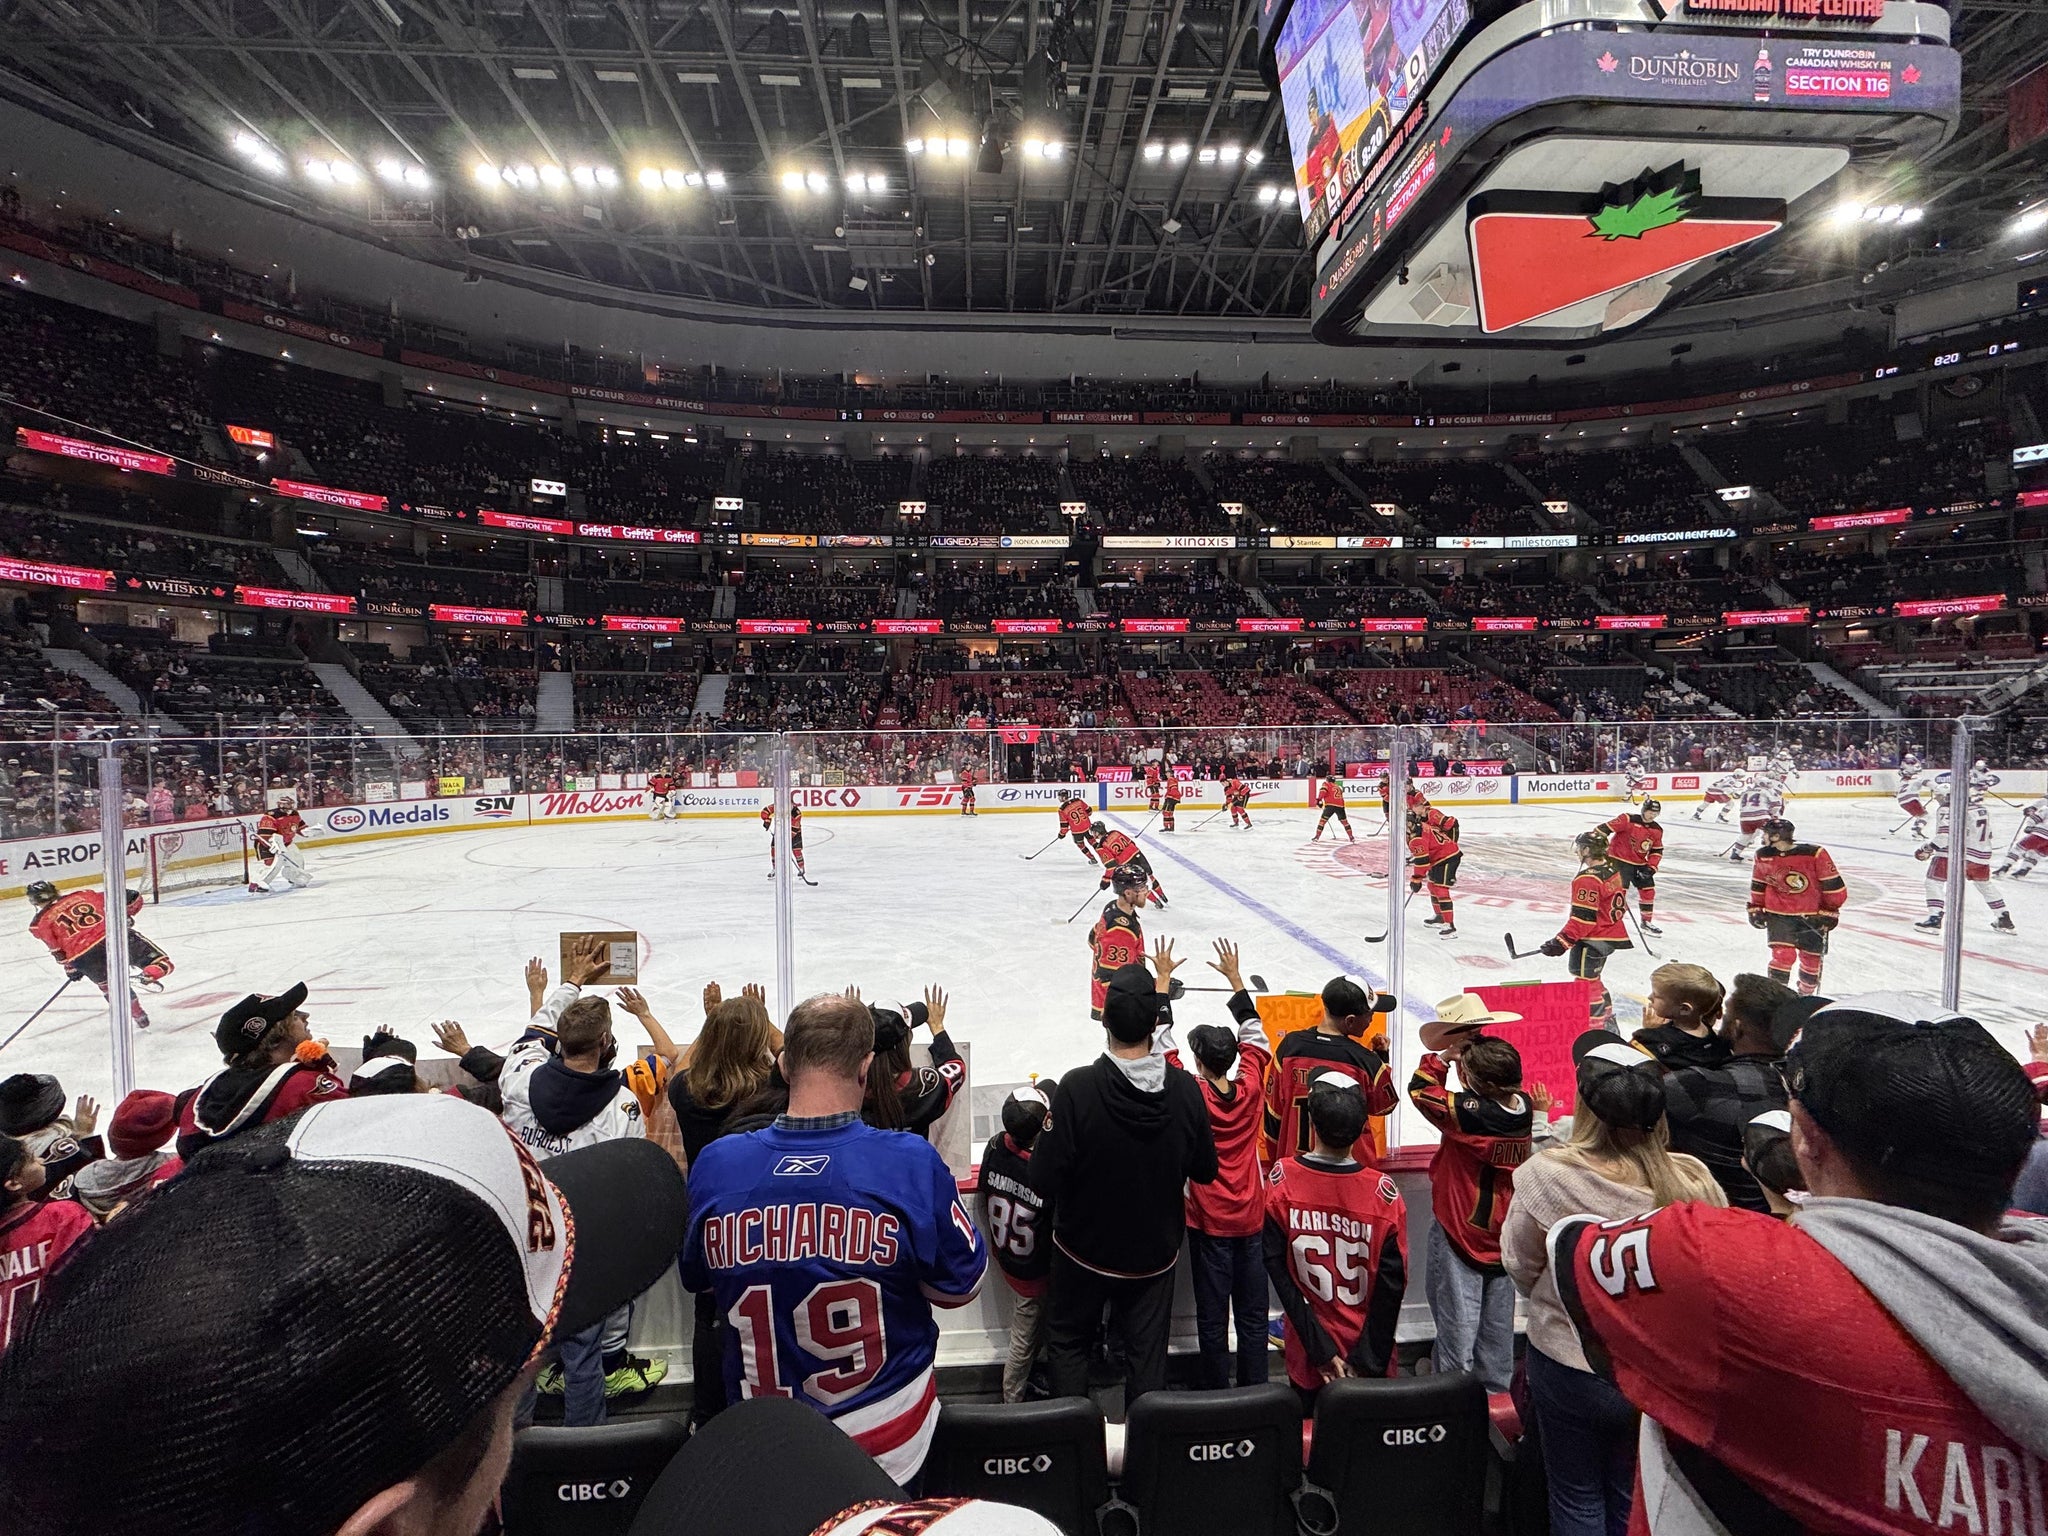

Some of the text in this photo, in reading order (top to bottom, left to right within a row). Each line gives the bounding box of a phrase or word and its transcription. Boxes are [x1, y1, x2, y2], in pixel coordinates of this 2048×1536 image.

[1802, 48, 1876, 60] TRY DUNROBIN
[1629, 56, 1740, 80] DUNROBIN
[1786, 57, 1892, 70] CANADIAN WHISKY IN
[1788, 75, 1889, 93] SECTION 116
[1361, 126, 1384, 168] 8:20
[1386, 158, 1435, 225] SECTION 116
[264, 314, 351, 346] GO GO
[571, 387, 704, 411] DU COEUR ARTIFICES
[883, 411, 935, 420] GO GO
[1056, 413, 1133, 422] HEART HYPE
[1261, 415, 1310, 424] GO GO
[1439, 413, 1553, 425] DU COEUR ARTIFICES
[61, 445, 141, 468] SECTION 116
[302, 491, 362, 507] SECTION 116
[415, 506, 453, 518] WHISKY
[1940, 502, 1985, 514] WHISKY
[505, 519, 540, 532] SECTION
[541, 523, 553, 532] 116
[1833, 517, 1872, 528] SECTION
[1872, 516, 1885, 525] 116
[1752, 523, 1798, 535] DUNROBIN
[931, 536, 971, 547] ALIGNED
[1013, 538, 1070, 546] KONICA MINOLTA
[1296, 538, 1322, 546] Stantec
[1511, 537, 1570, 547] milestones
[1624, 532, 1685, 544] ROBERTSON
[60, 575, 81, 587] 116
[145, 580, 209, 596] WHISKY
[264, 597, 332, 611] SECTION 116
[367, 603, 423, 616] DUNROBIN
[1916, 604, 1963, 615] SECTION
[1964, 603, 1981, 612] 116
[452, 613, 508, 624] SECTION 116
[1828, 607, 1874, 618] WHISKY
[546, 616, 585, 626] WHISKY
[1075, 621, 1108, 630] WHISKY
[1195, 621, 1232, 630] DUNROBIN
[1316, 620, 1348, 629] WHISKY
[1432, 620, 1468, 629] DUNROBIN
[1550, 619, 1582, 628] WHISKY
[1610, 621, 1640, 630] SECTION
[1641, 620, 1651, 629] 116
[1673, 616, 1717, 626] DUNROBIN
[1740, 616, 1775, 625] SECTION
[1777, 614, 1789, 623] 116
[621, 622, 656, 631] SECTION
[691, 622, 732, 631] DUNROBIN
[753, 625, 796, 633] SECTION 116
[825, 623, 858, 631] WHISKY
[888, 625, 928, 633] SECTION 116
[950, 622, 987, 631] DUNROBIN
[1007, 624, 1047, 633] SECTION 116
[1136, 624, 1175, 632] SECTION 116
[1251, 623, 1290, 631] SECTION 116
[1375, 623, 1413, 631] SECTION 116
[1486, 622, 1513, 631] SECTION
[1514, 622, 1524, 630] 116
[1527, 779, 1591, 793] Mondetta
[473, 796, 515, 812] SN
[539, 792, 644, 816] Molson
[682, 793, 717, 807] Coors
[718, 797, 760, 806] SELTZER
[791, 789, 838, 807] CIBC
[333, 814, 360, 826] Esso
[368, 803, 450, 827] Medals
[1975, 818, 1988, 842] 7
[1576, 888, 1598, 903] 85
[56, 902, 105, 939] 18
[1107, 945, 1129, 963] 33
[520, 1125, 573, 1154] BURGESS
[987, 1170, 1044, 1209] SANDERSON
[986, 1194, 1037, 1258] 85
[1289, 1208, 1373, 1244] KARLSSON
[704, 1202, 900, 1270] RICHARDS
[1291, 1233, 1371, 1307] 65
[727, 1276, 888, 1407] 19
[1382, 1427, 1428, 1446] CIBC
[1188, 1442, 1235, 1462] CIBC
[983, 1457, 1031, 1476] CIBC
[557, 1482, 607, 1502] CIBC
